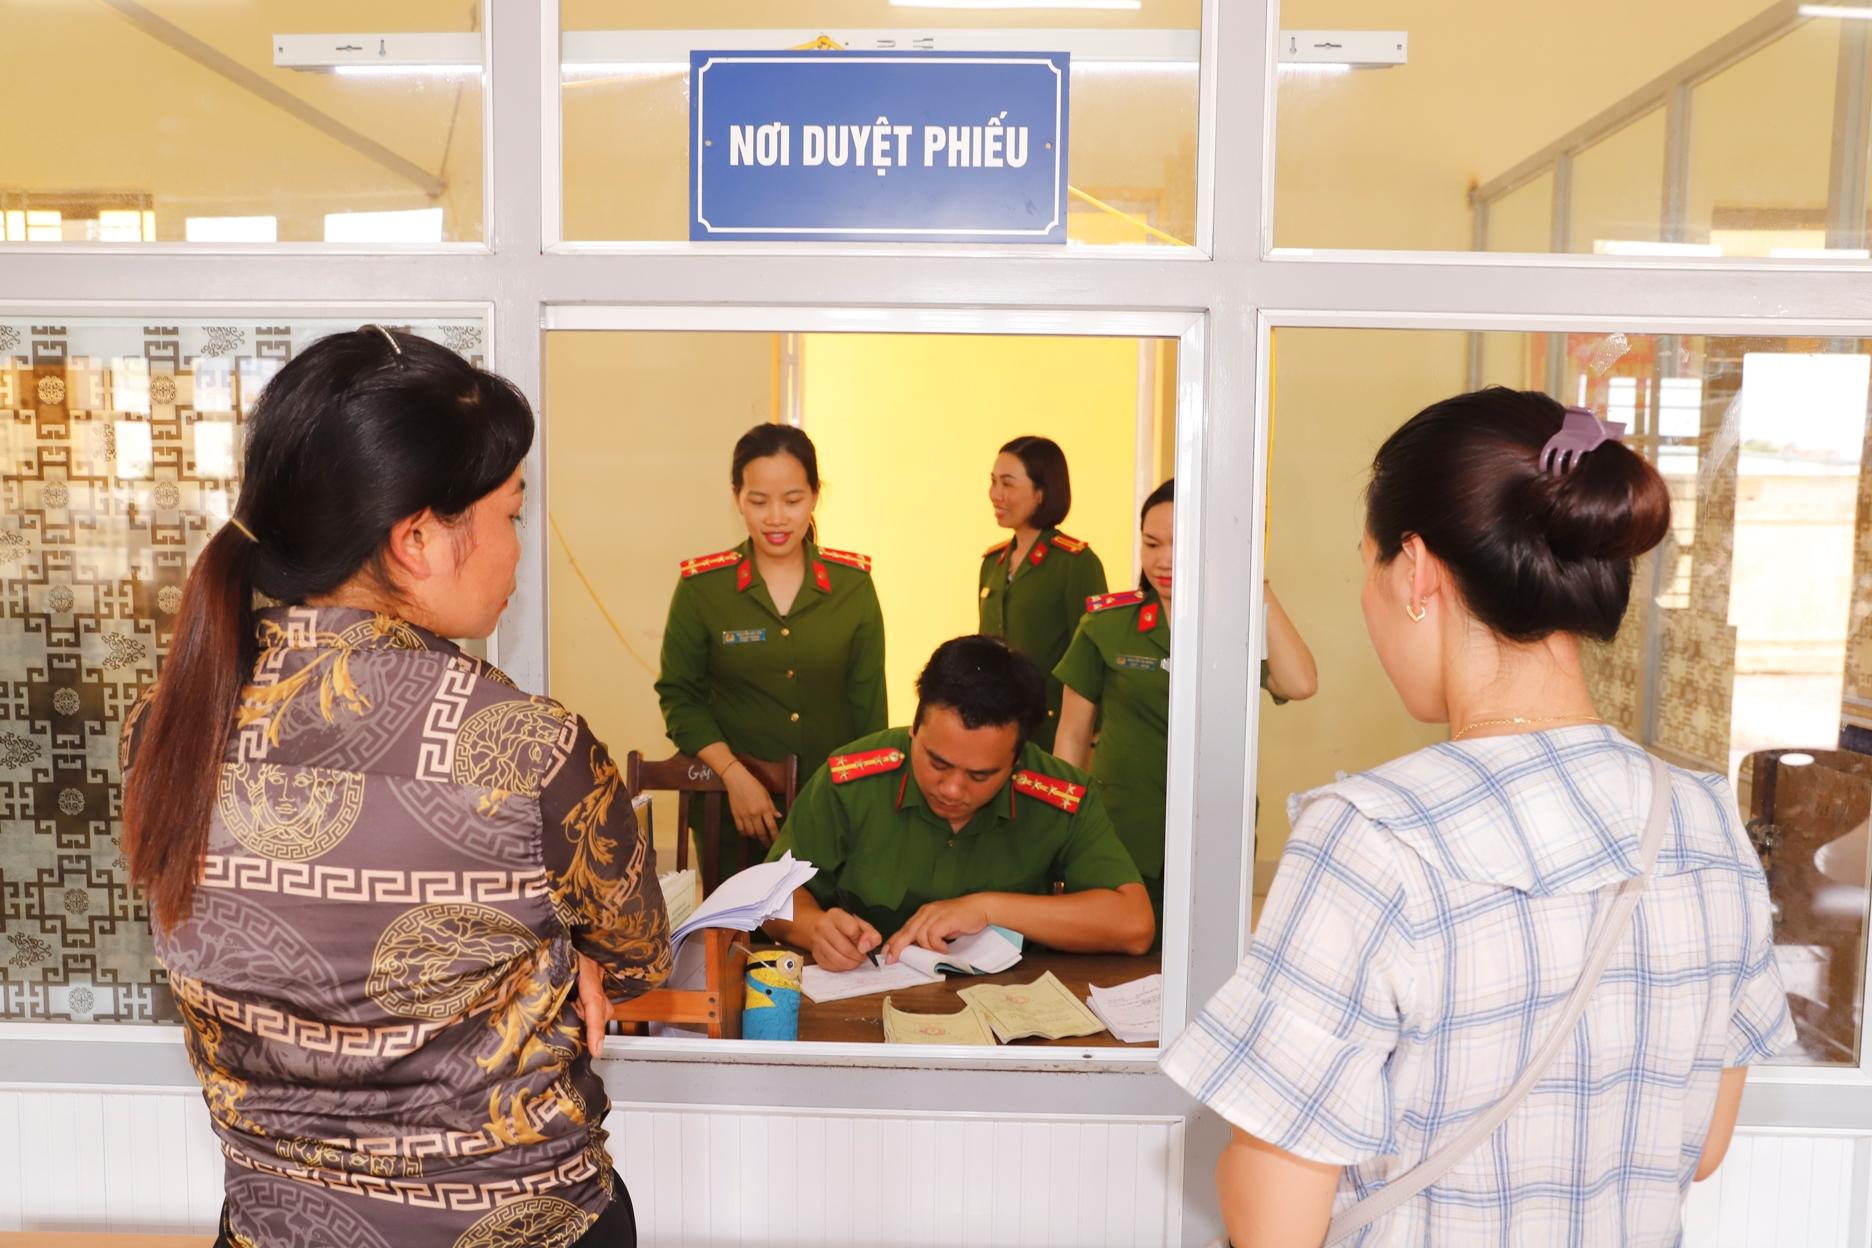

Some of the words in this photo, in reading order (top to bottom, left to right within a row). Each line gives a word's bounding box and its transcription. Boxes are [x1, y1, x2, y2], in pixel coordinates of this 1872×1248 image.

[730, 121, 790, 167] NƠI
[803, 116, 912, 177] DUYỆT
[924, 111, 1028, 168] PHIẾU
